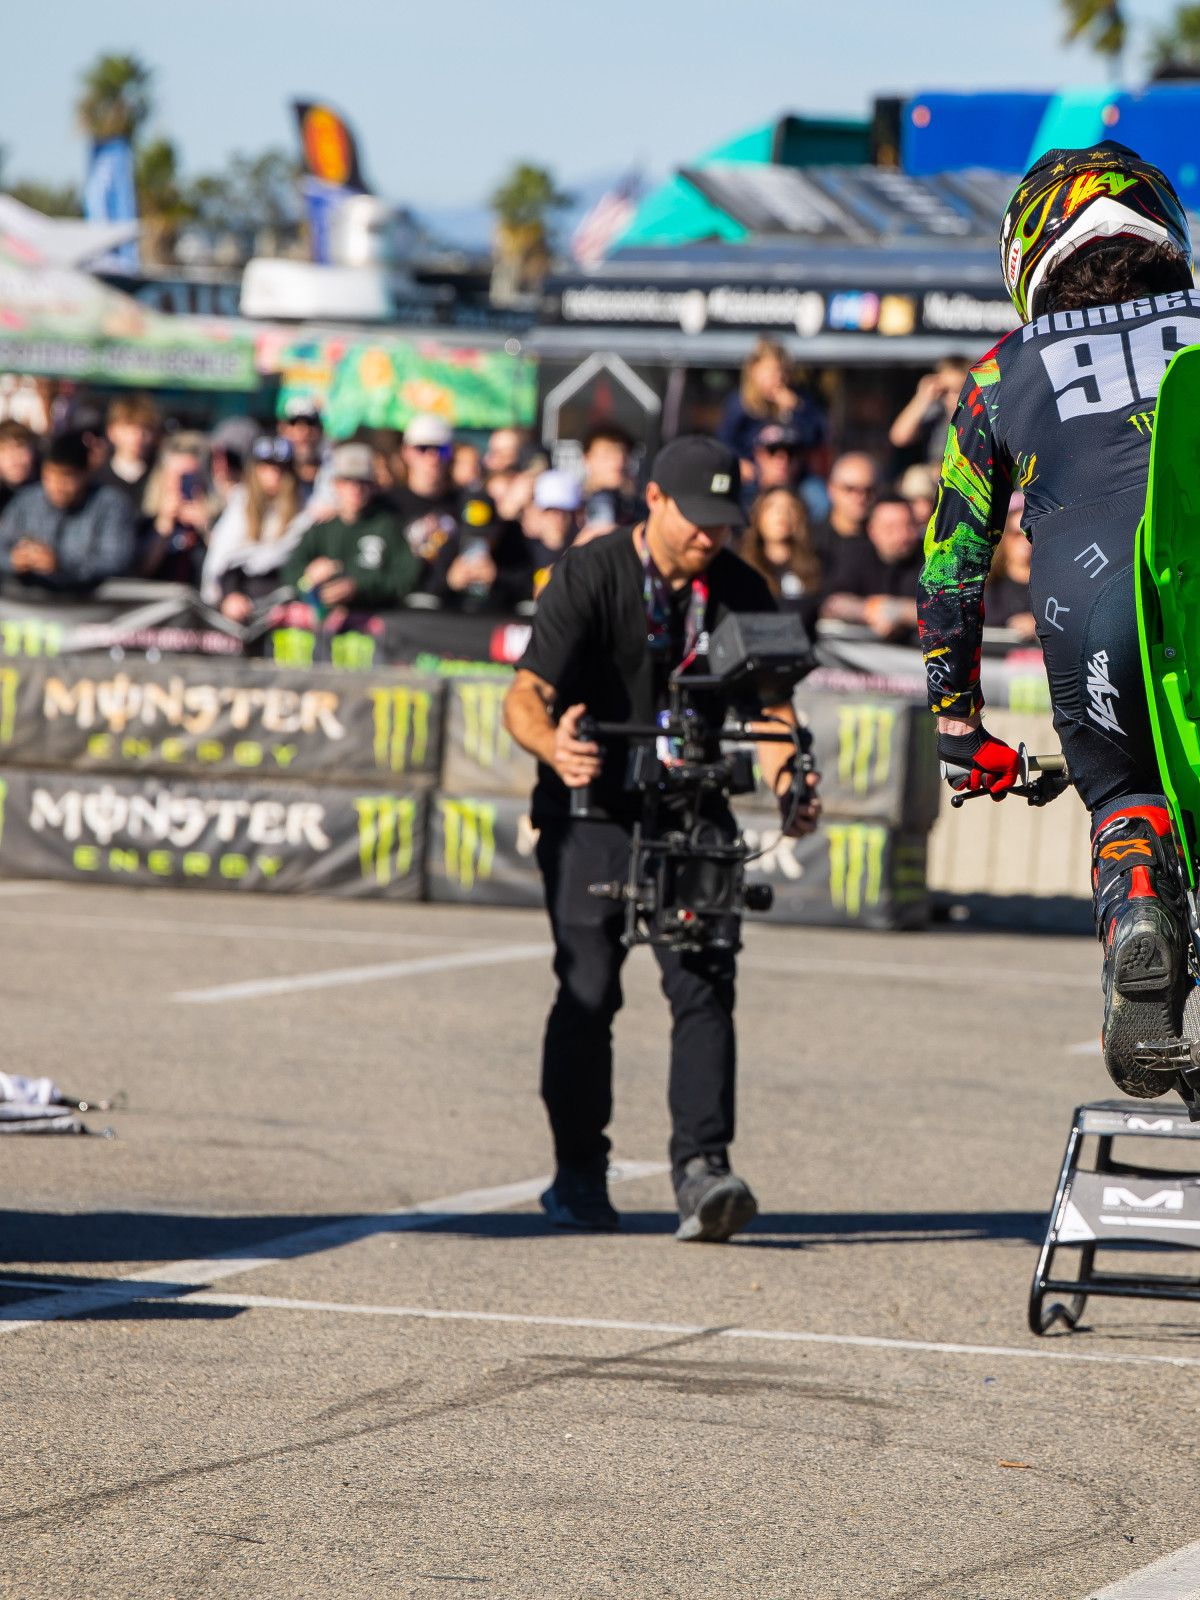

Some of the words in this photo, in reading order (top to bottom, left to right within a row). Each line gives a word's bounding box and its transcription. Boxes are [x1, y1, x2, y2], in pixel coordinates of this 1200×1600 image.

[1009, 246, 1020, 281] BELL
[43, 673, 346, 740] MONSTER
[87, 734, 298, 769] ENERGY
[29, 784, 332, 851] MONSTER
[73, 844, 283, 880] ENERGY
